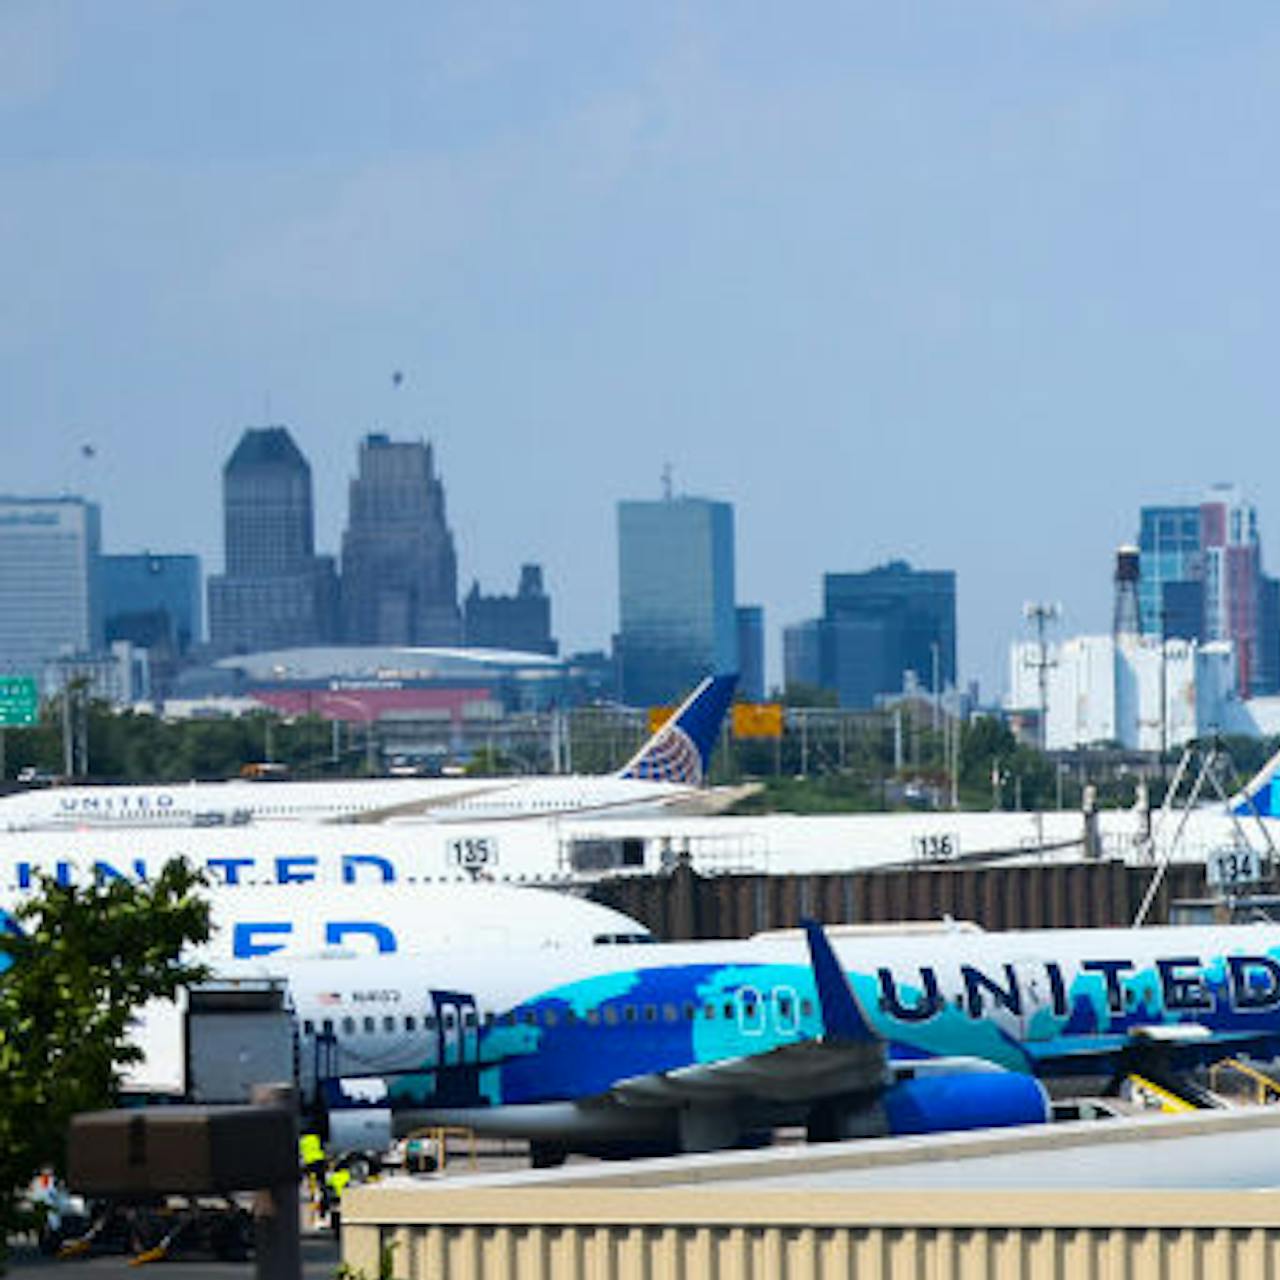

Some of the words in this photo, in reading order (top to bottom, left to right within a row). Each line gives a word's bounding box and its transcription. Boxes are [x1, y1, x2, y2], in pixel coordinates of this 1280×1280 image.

[59, 795, 174, 811] UNITED
[453, 838, 488, 864] 135
[919, 835, 953, 856] 136
[1217, 854, 1252, 881] 134
